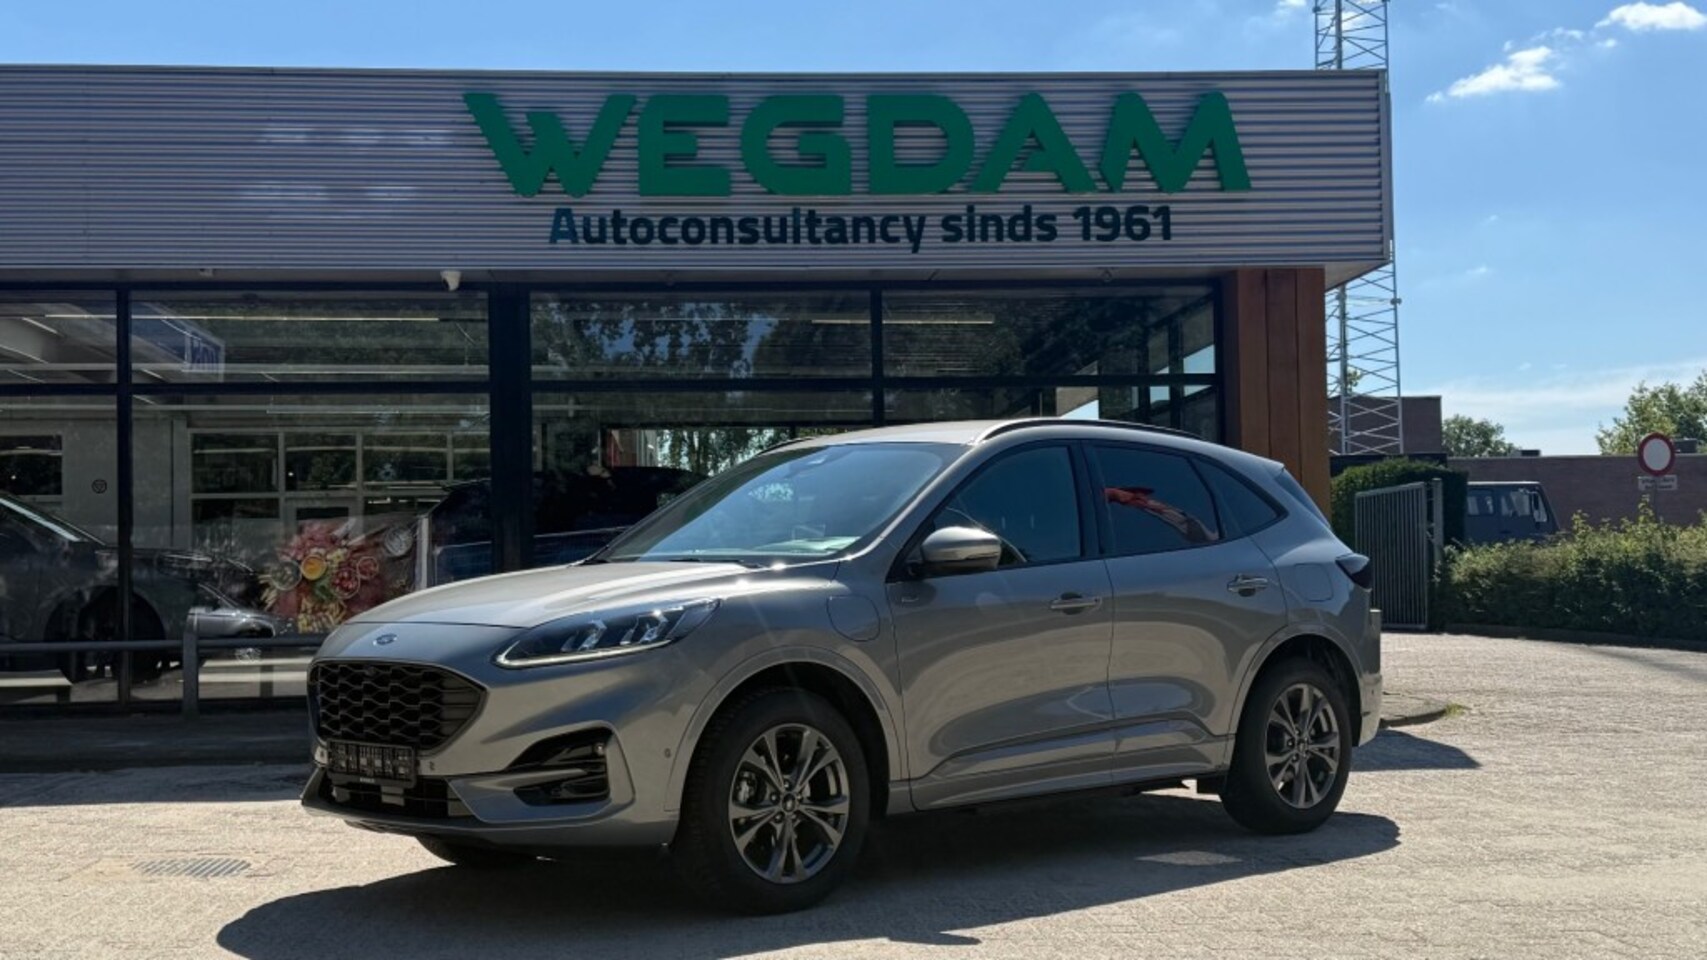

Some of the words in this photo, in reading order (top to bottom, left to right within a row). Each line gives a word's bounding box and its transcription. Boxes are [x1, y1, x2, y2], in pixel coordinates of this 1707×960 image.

[462, 91, 1252, 198] WEGDAM
[549, 207, 926, 254] Autoconsultancy
[941, 205, 1058, 243] sinds
[1072, 205, 1172, 242] 1961
